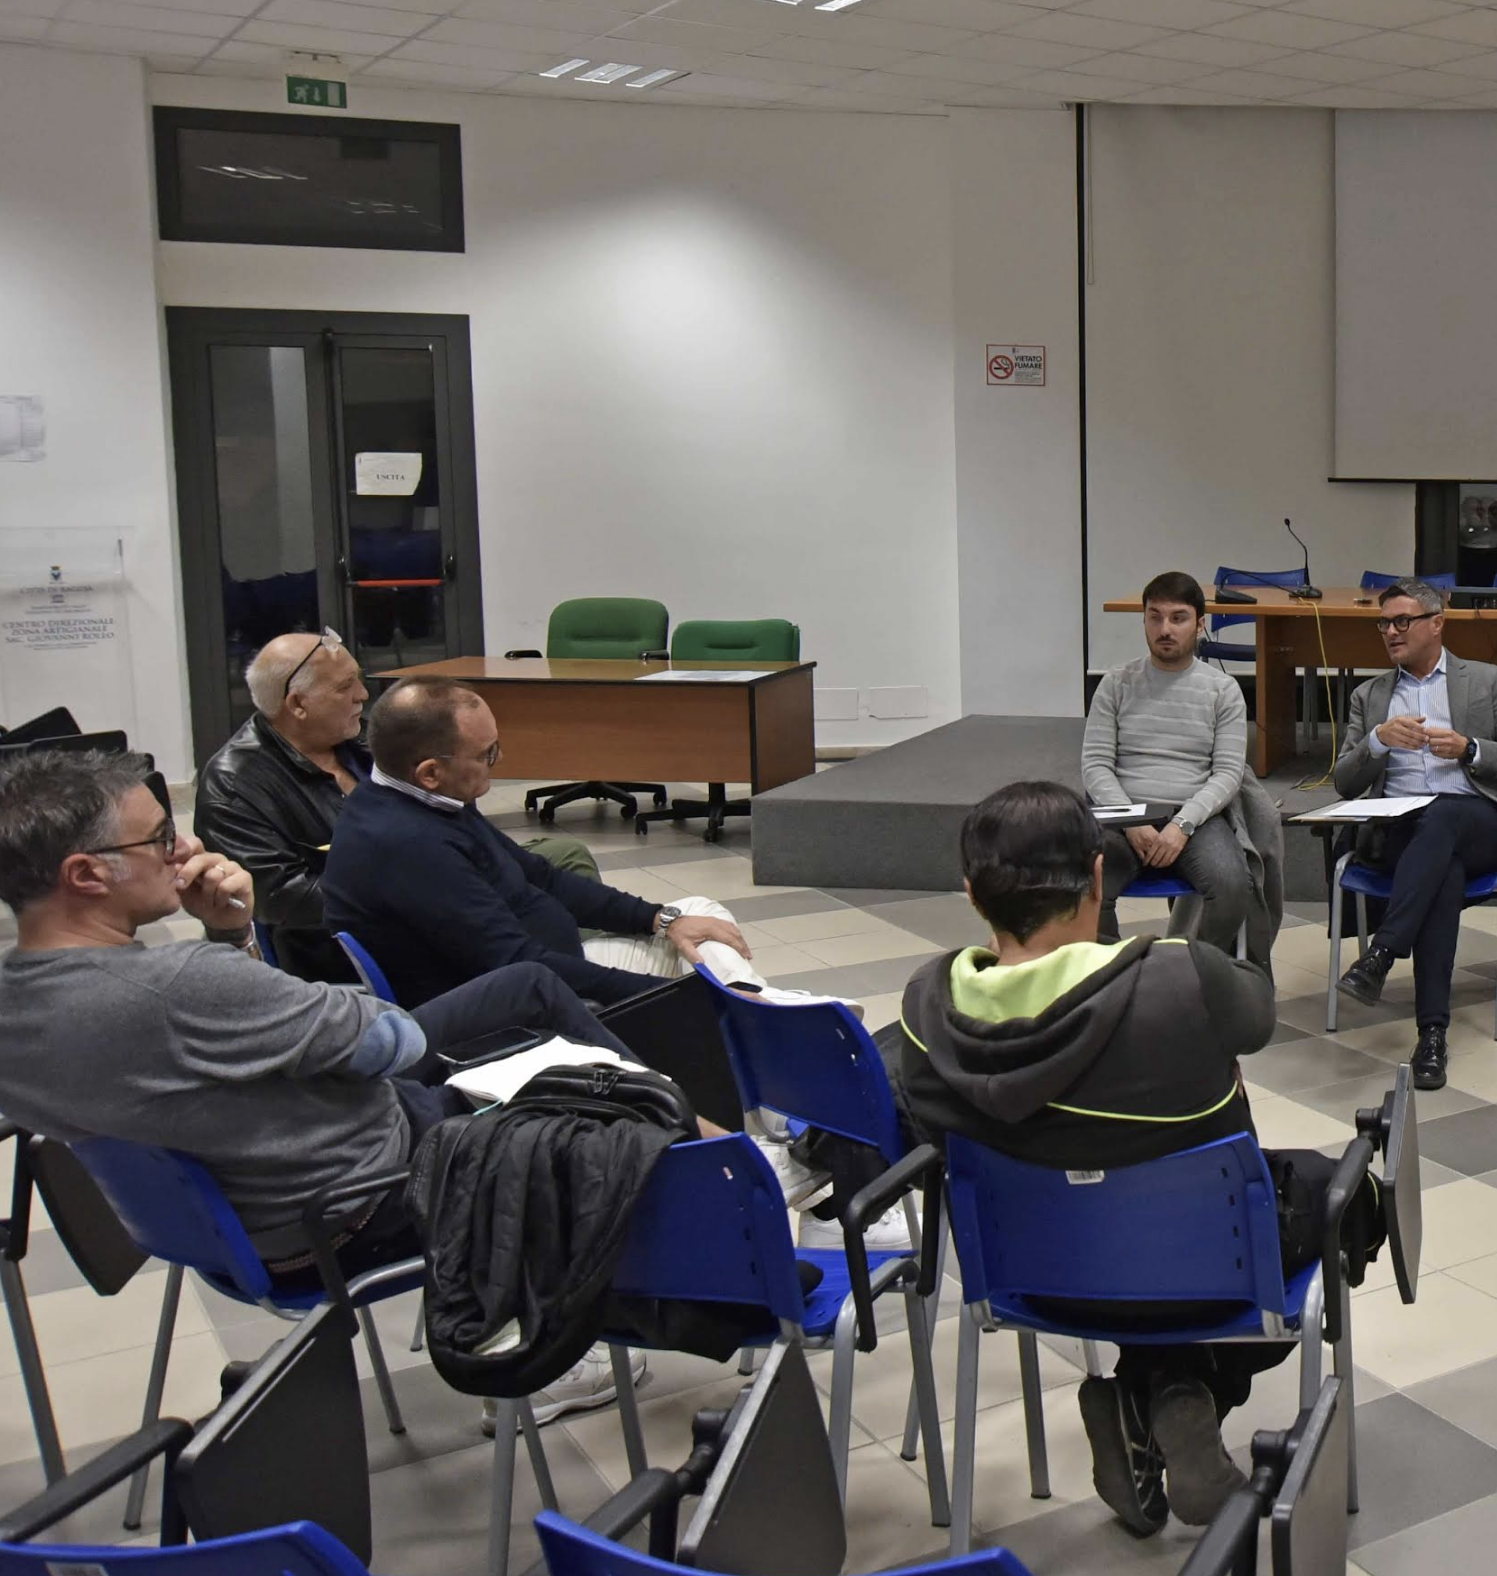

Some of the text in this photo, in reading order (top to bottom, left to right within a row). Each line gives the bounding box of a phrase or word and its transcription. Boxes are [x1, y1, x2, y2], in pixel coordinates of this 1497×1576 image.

[2, 618, 114, 629] CENTRO DIREZIONALE
[12, 625, 107, 636] ZONA ARTIGIANALE
